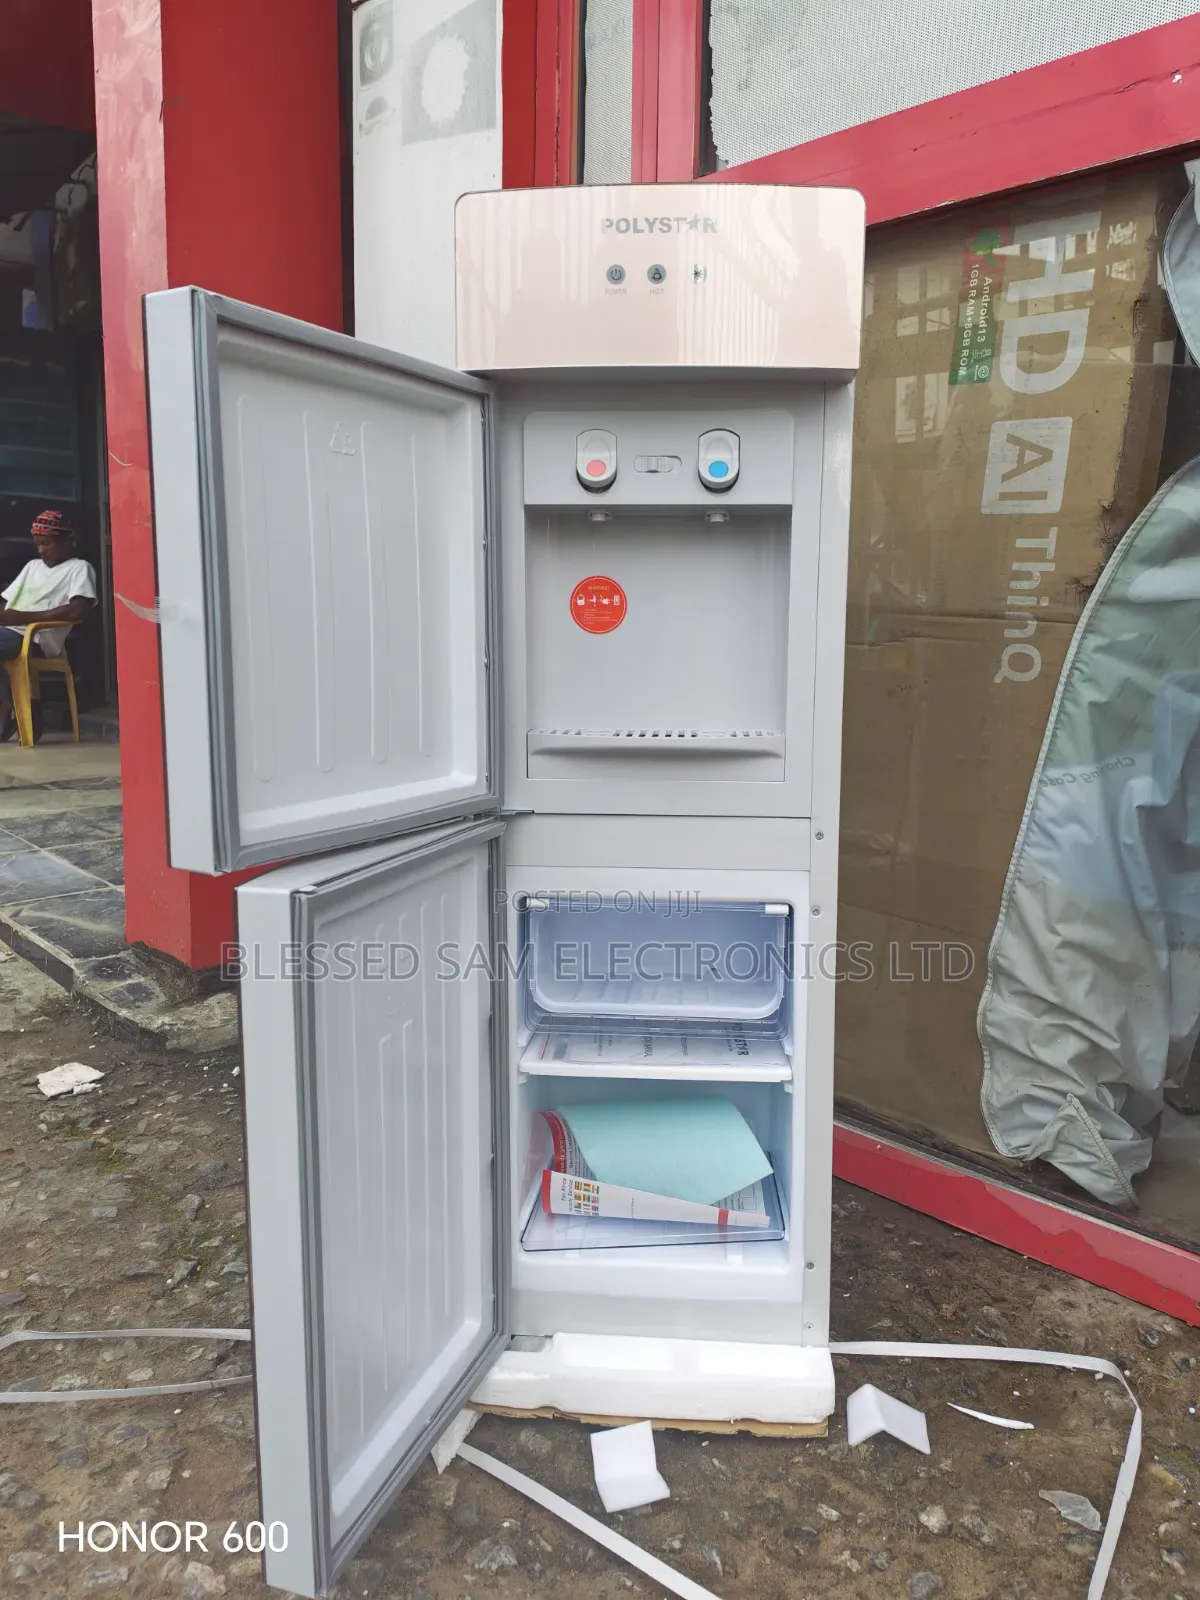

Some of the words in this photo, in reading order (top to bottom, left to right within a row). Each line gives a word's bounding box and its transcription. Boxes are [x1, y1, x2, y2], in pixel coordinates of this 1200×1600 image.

[969, 263, 980, 287] 1GB
[962, 289, 977, 347] RAM+8GB
[976, 276, 993, 343] Android13
[957, 349, 970, 376] ROM
[997, 432, 1053, 502] AI
[993, 526, 1058, 685] ThinQ
